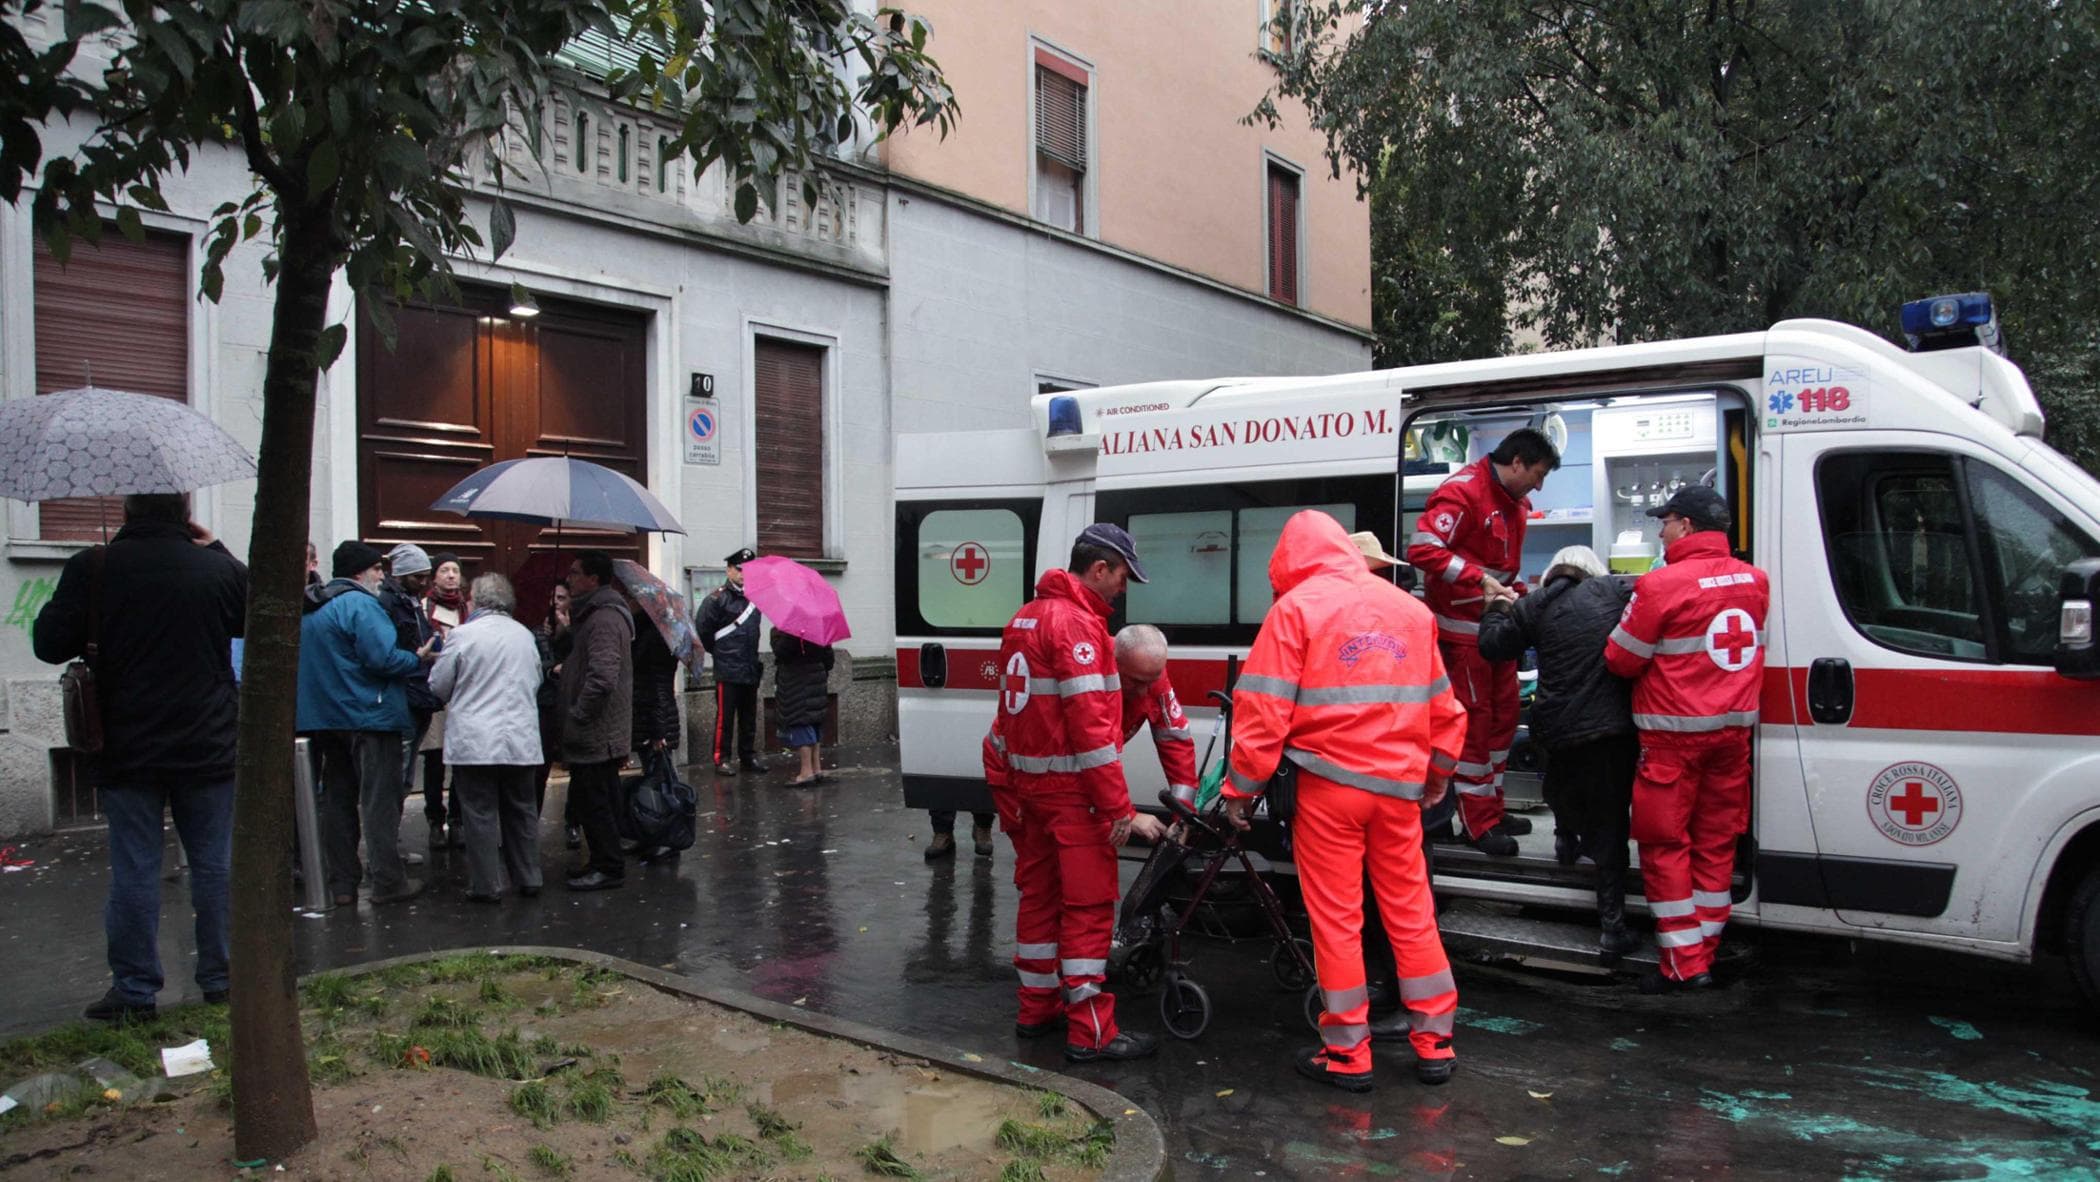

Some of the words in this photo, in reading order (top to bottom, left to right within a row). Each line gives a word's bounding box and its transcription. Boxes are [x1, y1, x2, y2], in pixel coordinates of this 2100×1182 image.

[1769, 366, 1833, 385] AREU
[1106, 405, 1119, 415] AIR
[1120, 402, 1170, 415] CONDITIONED
[1797, 386, 1850, 413] 118
[1189, 421, 1237, 448] SAN
[1244, 411, 1354, 444] DONATO
[1362, 409, 1393, 435] M.
[1782, 416, 1866, 427] RegioneLombardia
[1871, 773, 1894, 805] CROCE
[1891, 764, 1925, 778] ROSSA
[1926, 768, 1958, 809] ITALIANA
